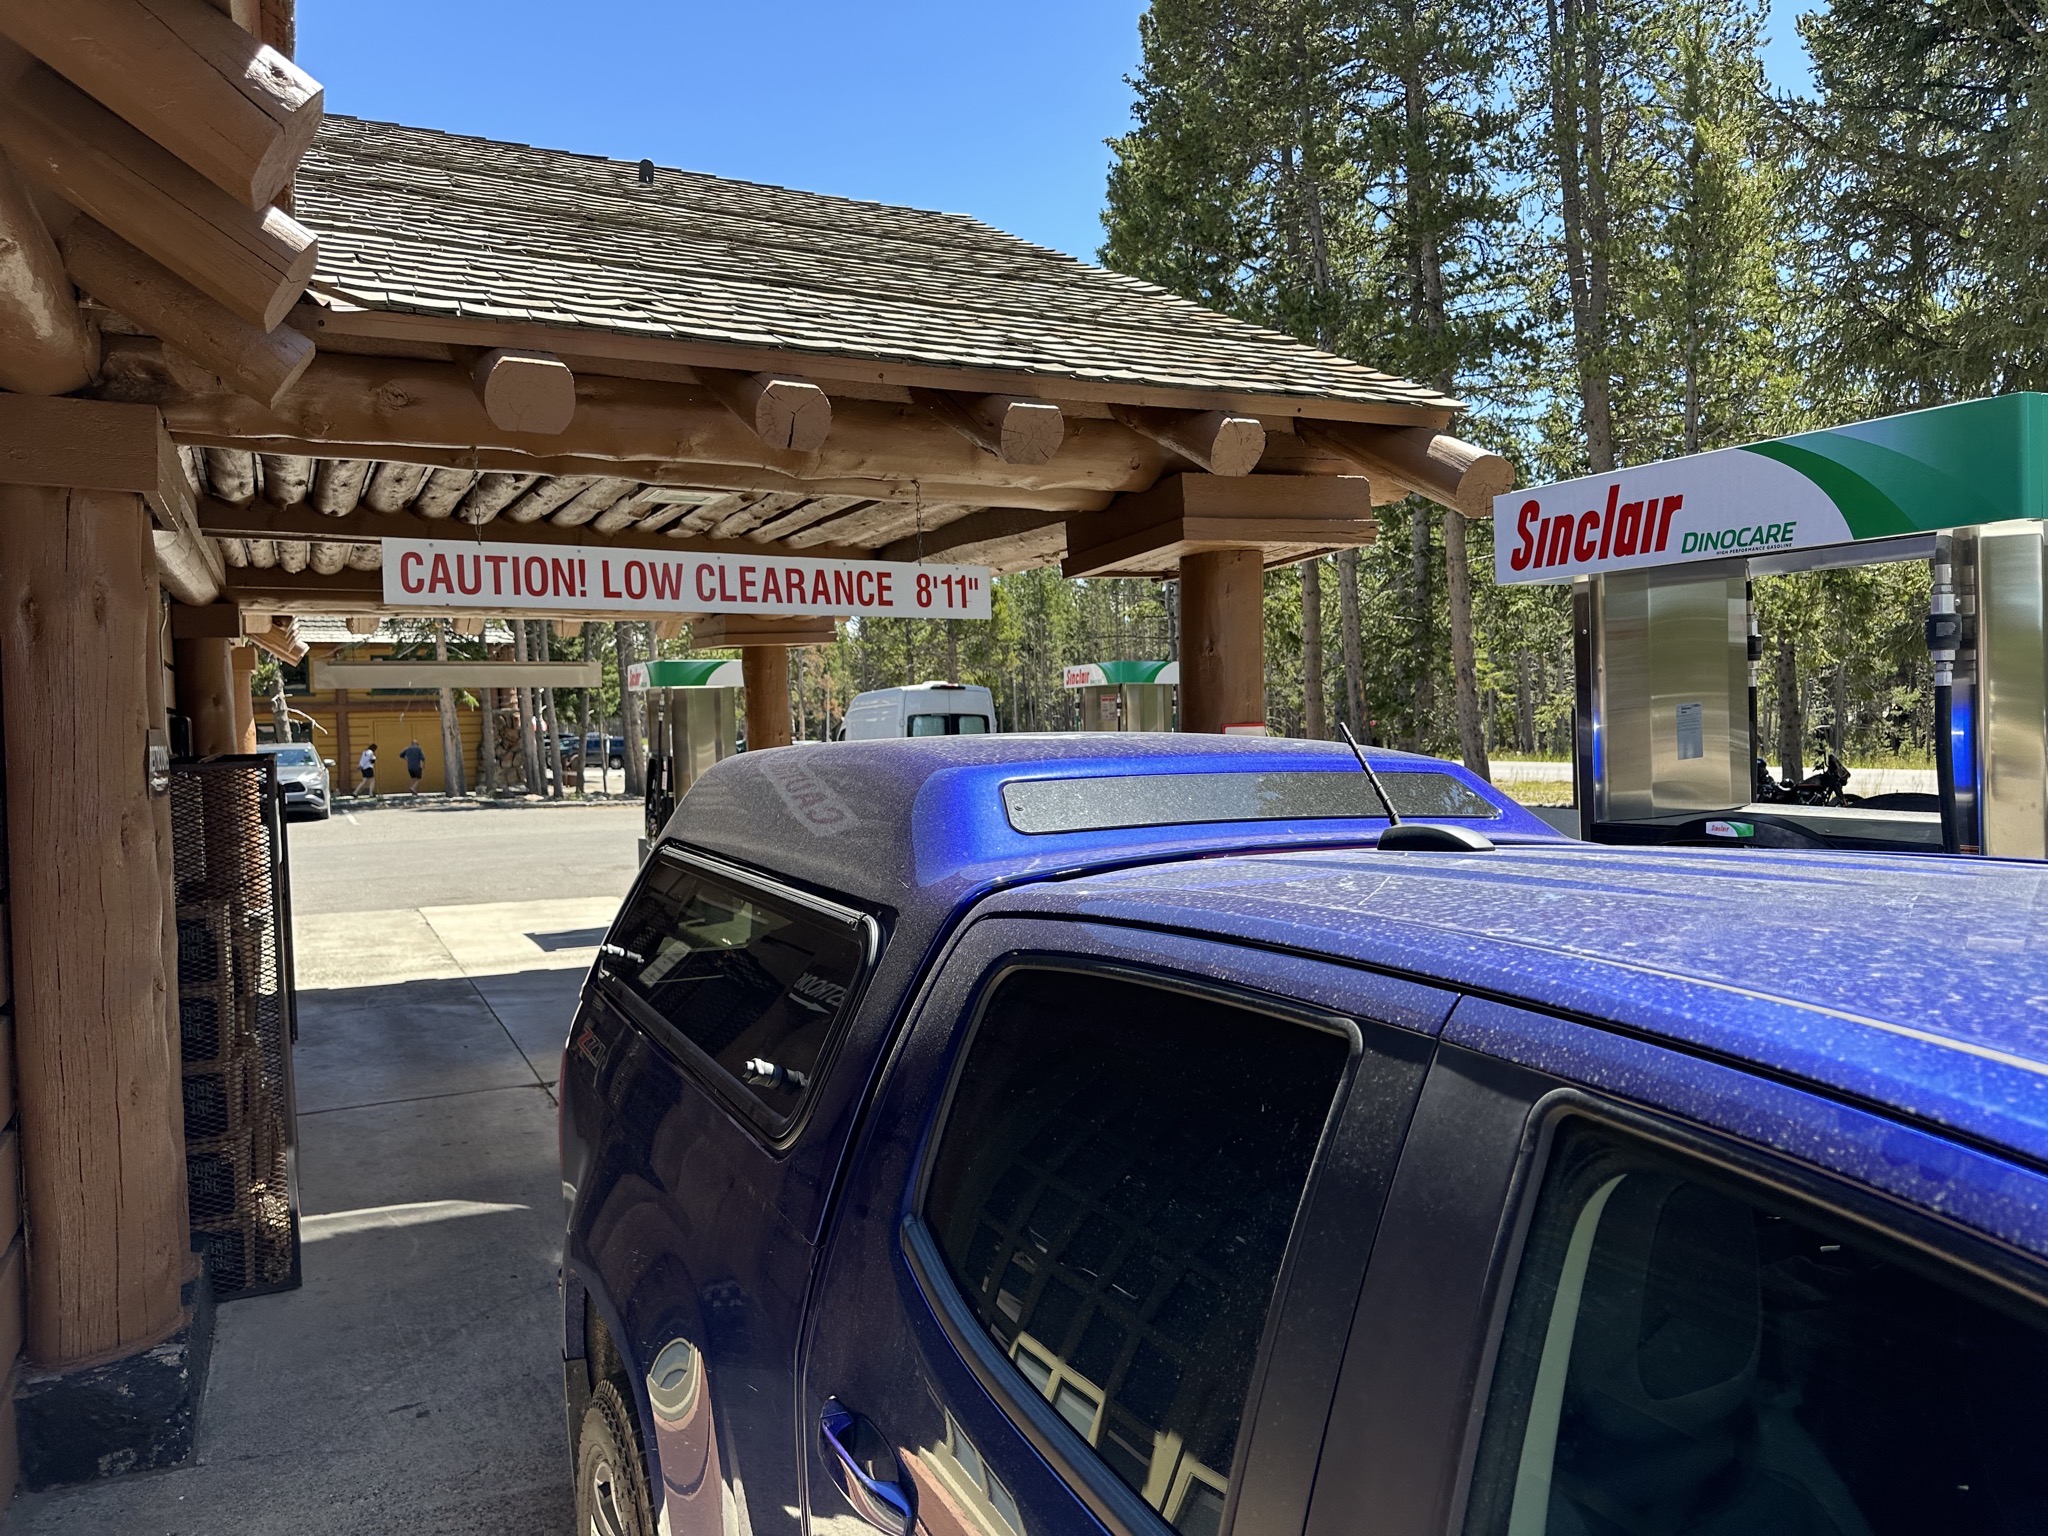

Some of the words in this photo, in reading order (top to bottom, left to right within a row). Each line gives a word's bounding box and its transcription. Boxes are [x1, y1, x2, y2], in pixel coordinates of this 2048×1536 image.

[1510, 484, 1684, 571] Sinclair
[1681, 521, 1797, 554] DINOCARE
[1729, 545, 1765, 554] PERFORMANCE
[1766, 542, 1792, 550] GASOLINE
[400, 551, 586, 597] CAUTION!
[602, 560, 684, 600] LOW
[695, 563, 893, 606] CLEARANCE
[916, 573, 979, 609] 8'11"
[1066, 669, 1090, 686] Sinclair
